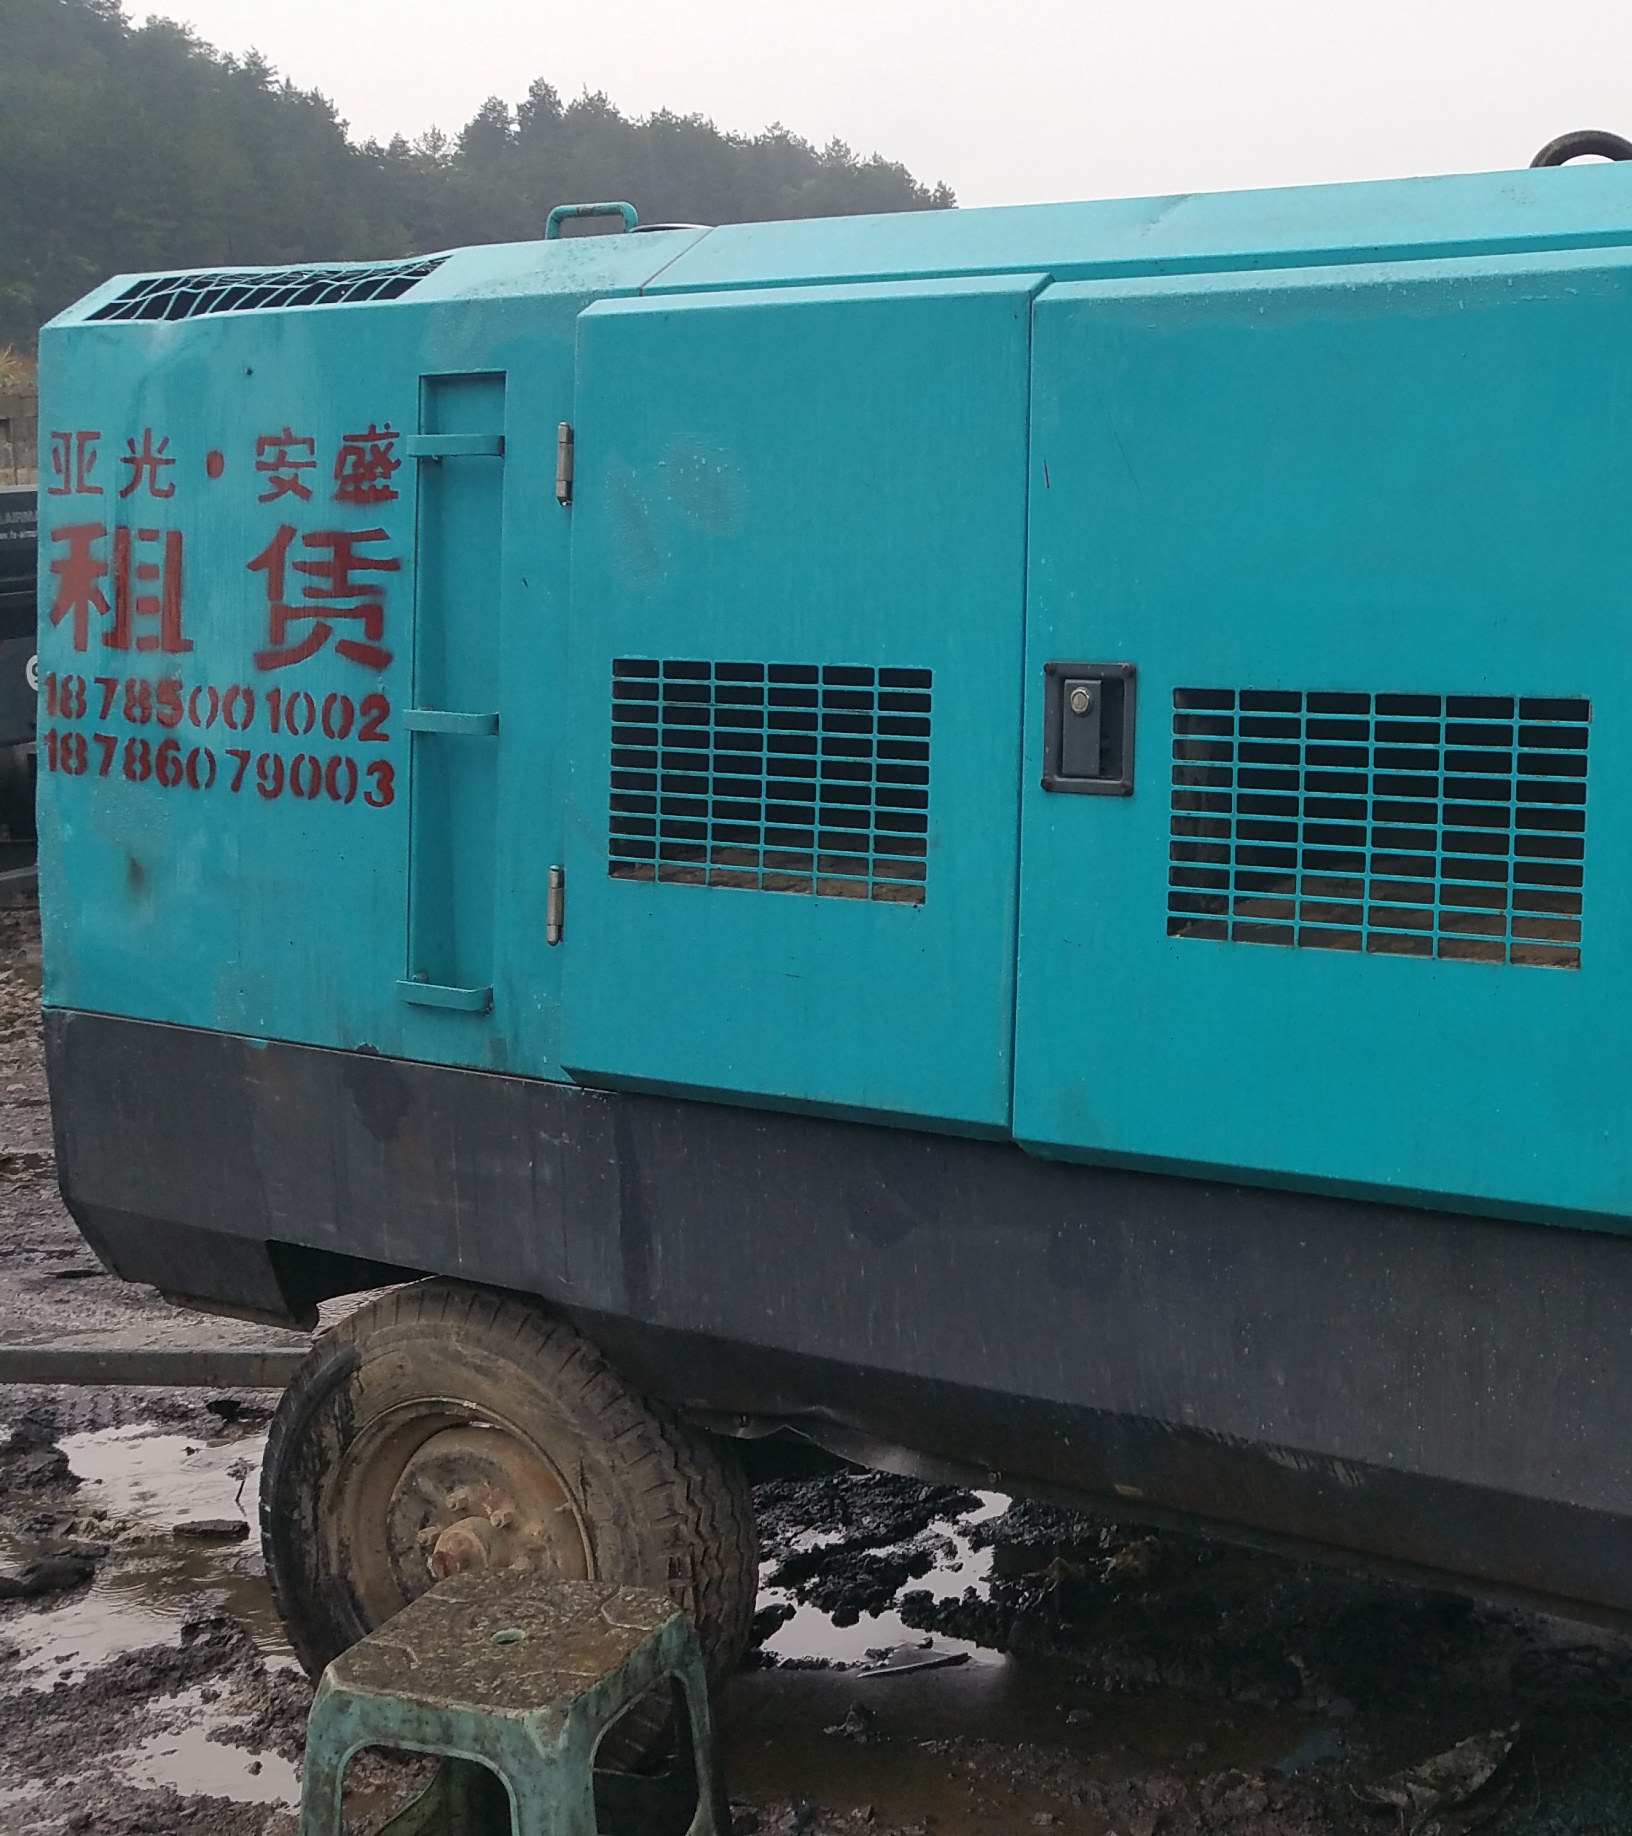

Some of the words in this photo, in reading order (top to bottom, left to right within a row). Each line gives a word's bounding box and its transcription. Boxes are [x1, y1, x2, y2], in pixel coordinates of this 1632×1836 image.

[48, 523, 402, 673] 租赁
[43, 673, 392, 743] 18785001002
[43, 727, 396, 808] 18786079003
